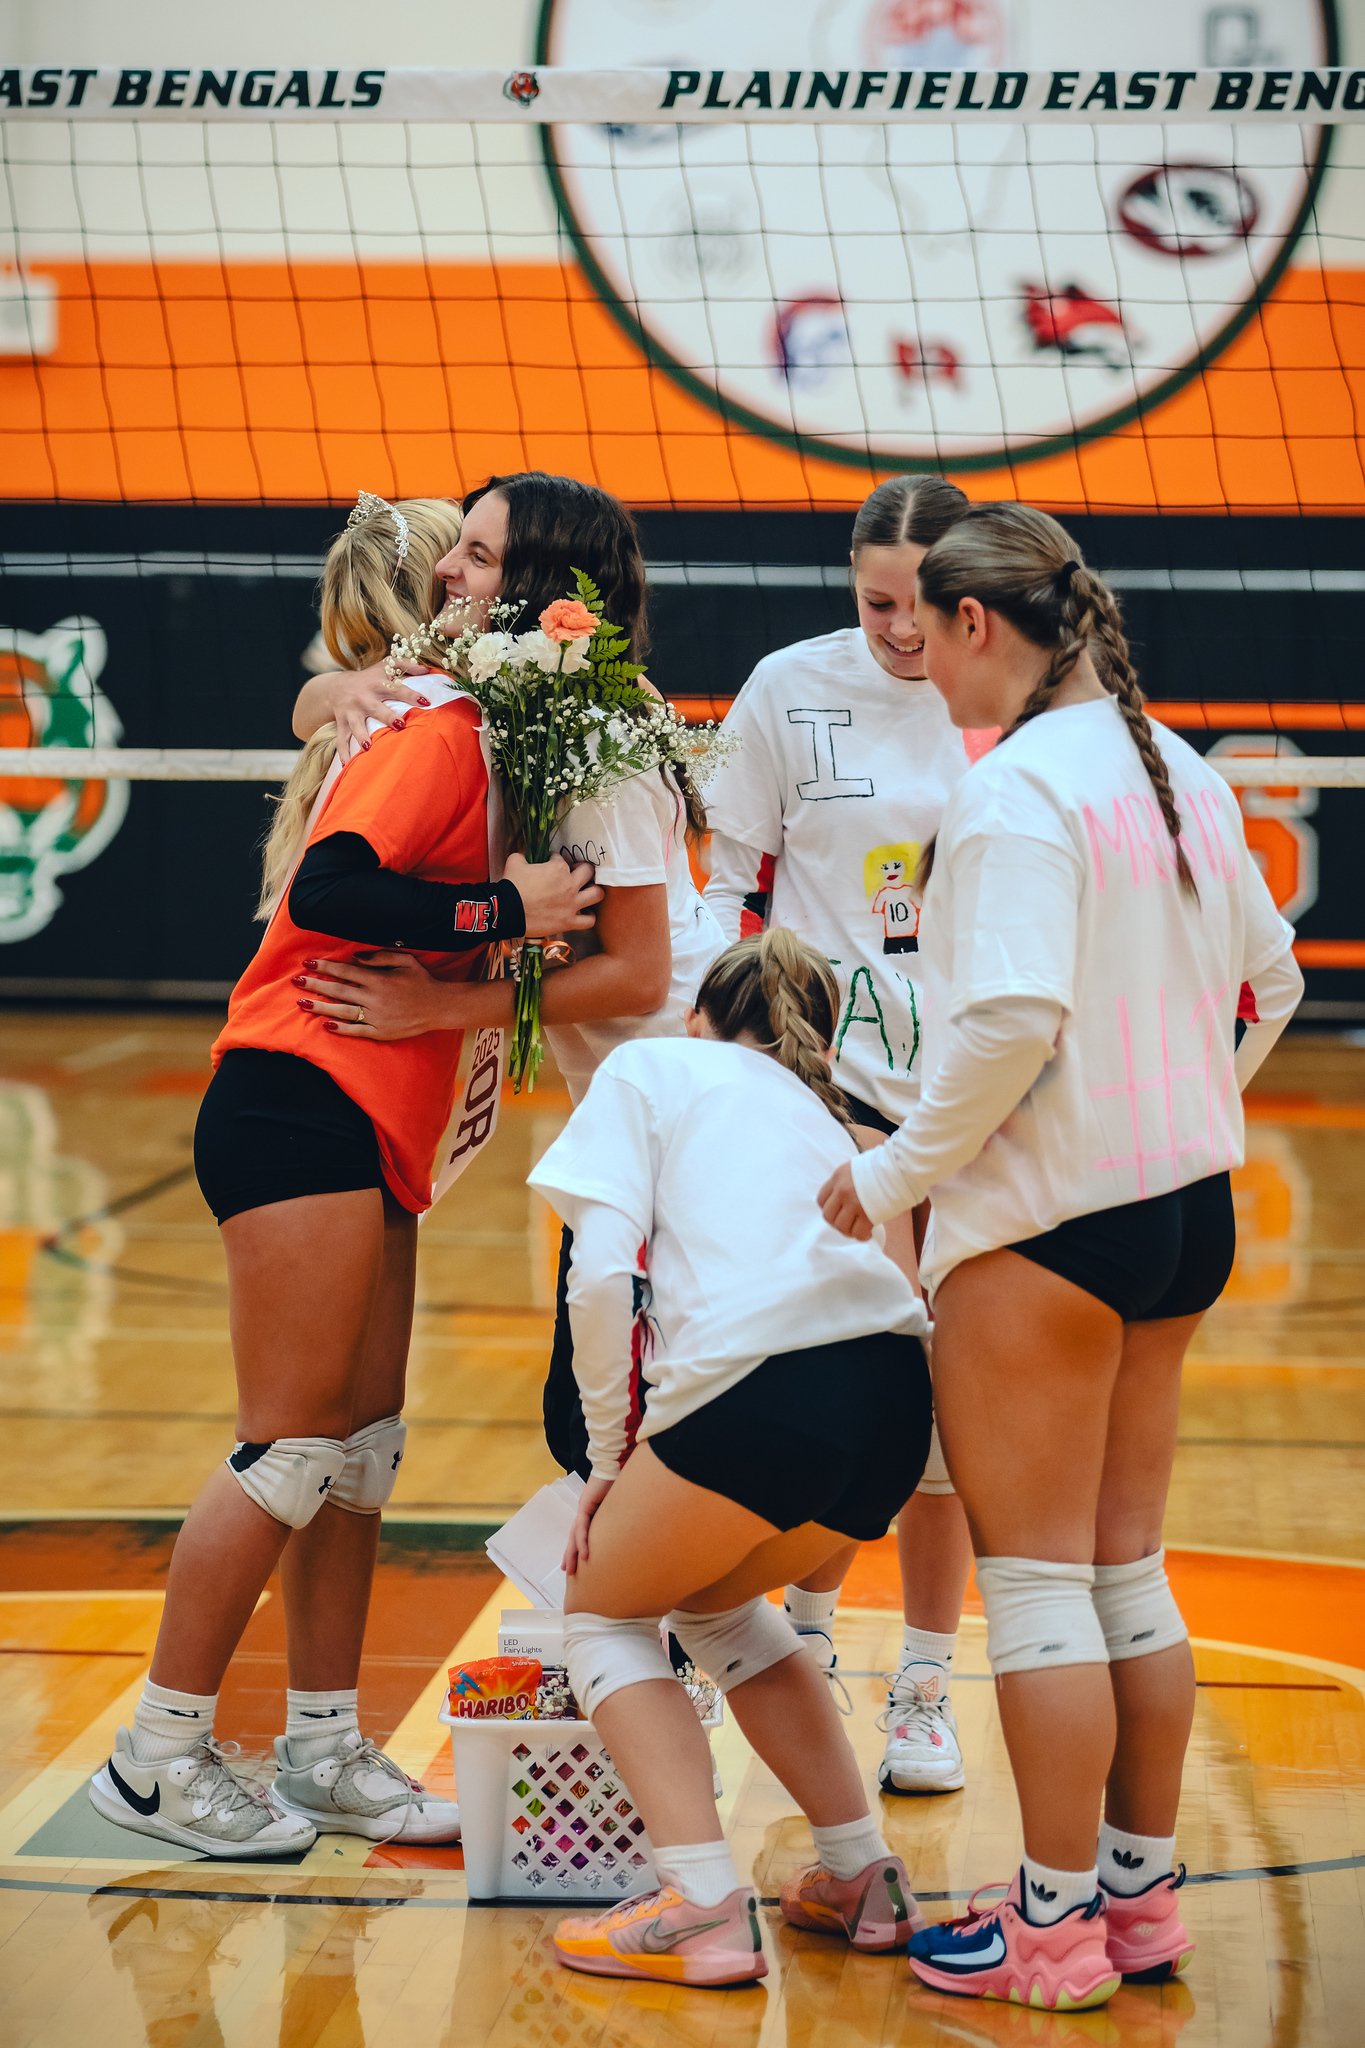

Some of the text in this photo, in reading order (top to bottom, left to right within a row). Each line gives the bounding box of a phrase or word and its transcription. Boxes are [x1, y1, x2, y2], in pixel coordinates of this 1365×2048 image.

[110, 69, 387, 108] BENGALS
[659, 70, 1030, 110] PLAINFIELD
[1041, 71, 1197, 111] EAST
[787, 708, 875, 802] I
[888, 901, 909, 924] 10
[471, 1027, 500, 1072] 2025
[503, 1646, 543, 1655] Fairy Lights
[458, 1692, 530, 1719] HARIBO
